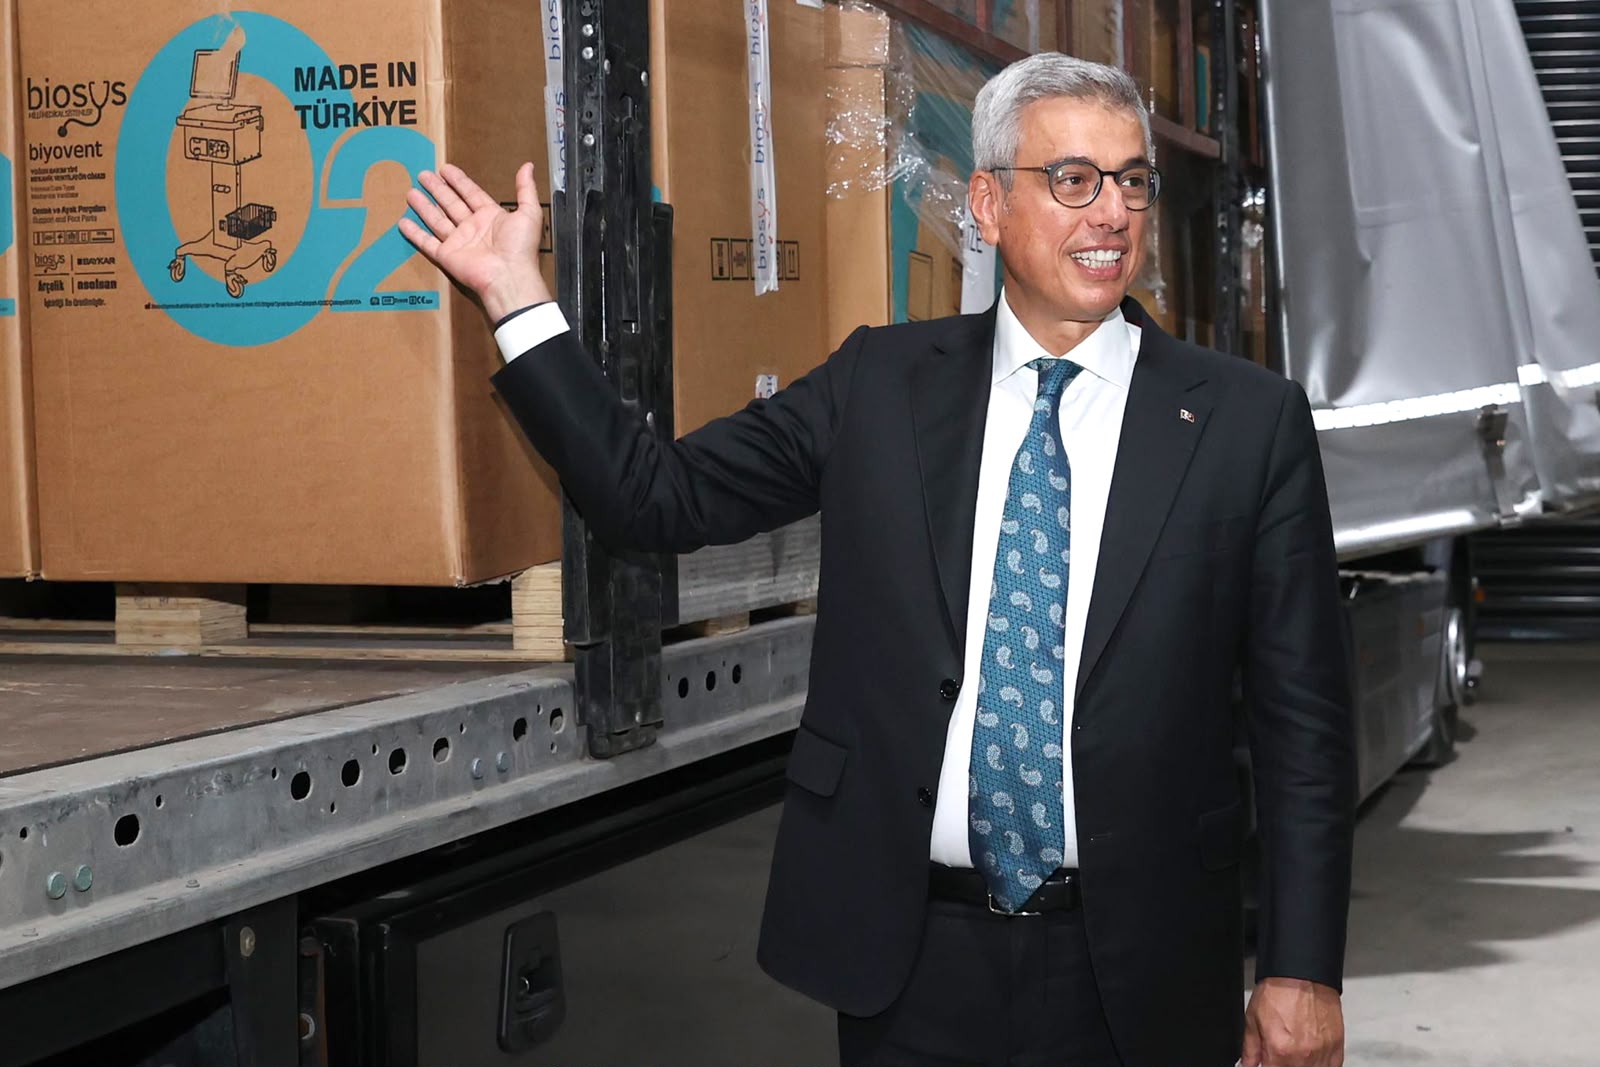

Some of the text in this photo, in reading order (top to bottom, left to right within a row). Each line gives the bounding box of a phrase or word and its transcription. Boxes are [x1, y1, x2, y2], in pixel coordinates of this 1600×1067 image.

[294, 61, 416, 92] MADE IN
[27, 77, 127, 137] biosys
[294, 96, 417, 129] TÜRKİYE
[29, 141, 103, 164] biyovent
[757, 188, 772, 269] biosys
[82, 257, 115, 265] BAYKAR
